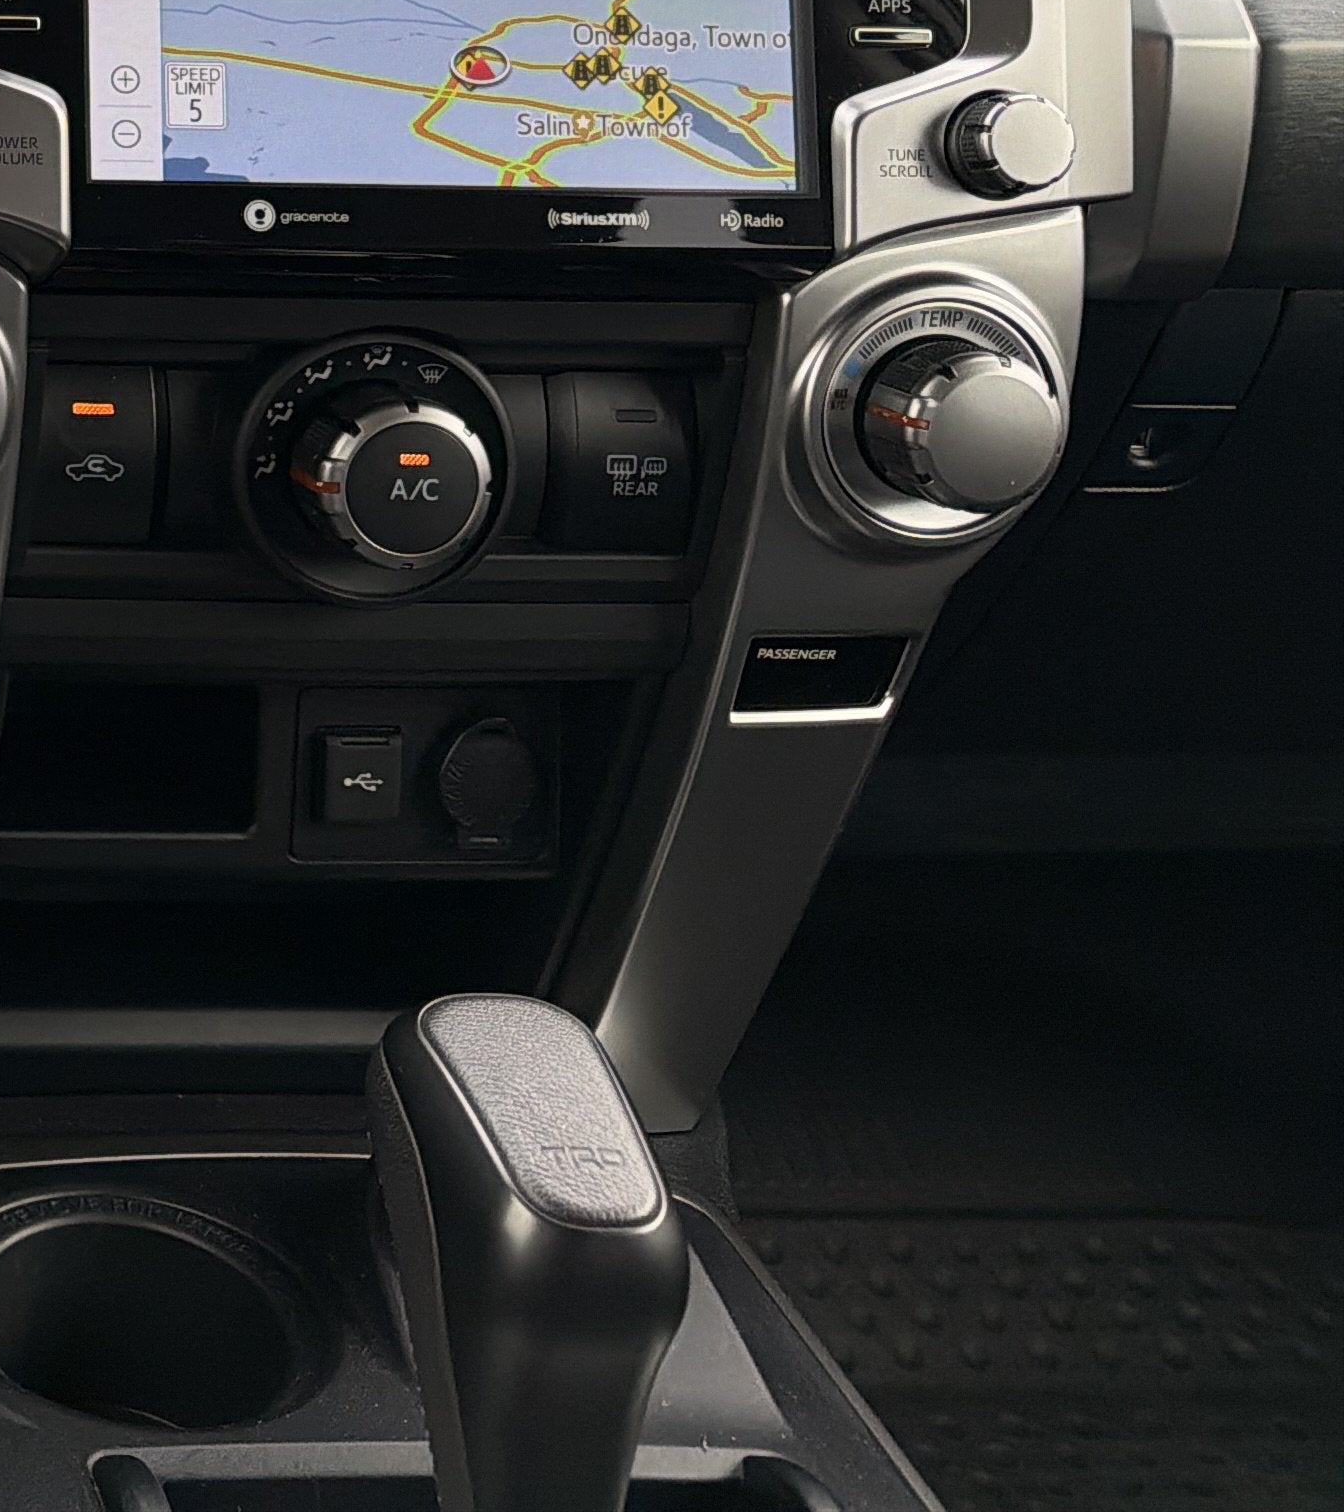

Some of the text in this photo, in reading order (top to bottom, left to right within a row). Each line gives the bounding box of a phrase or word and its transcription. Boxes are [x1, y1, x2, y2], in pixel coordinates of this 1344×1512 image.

[703, 25, 766, 49] Town
[772, 28, 791, 49] o
[170, 67, 220, 82] SPEED
[175, 82, 217, 96] LIMIT
[189, 98, 203, 123] 5
[597, 114, 660, 138] Town
[666, 115, 692, 138] of
[887, 148, 926, 163] TUNE
[879, 164, 933, 179] SCROLL
[279, 211, 351, 225] gracenote
[744, 213, 784, 228] Radio
[920, 310, 964, 329] TEMP
[388, 477, 441, 502] A/C
[612, 480, 659, 497] REAR
[756, 647, 837, 661] PASSENGER
